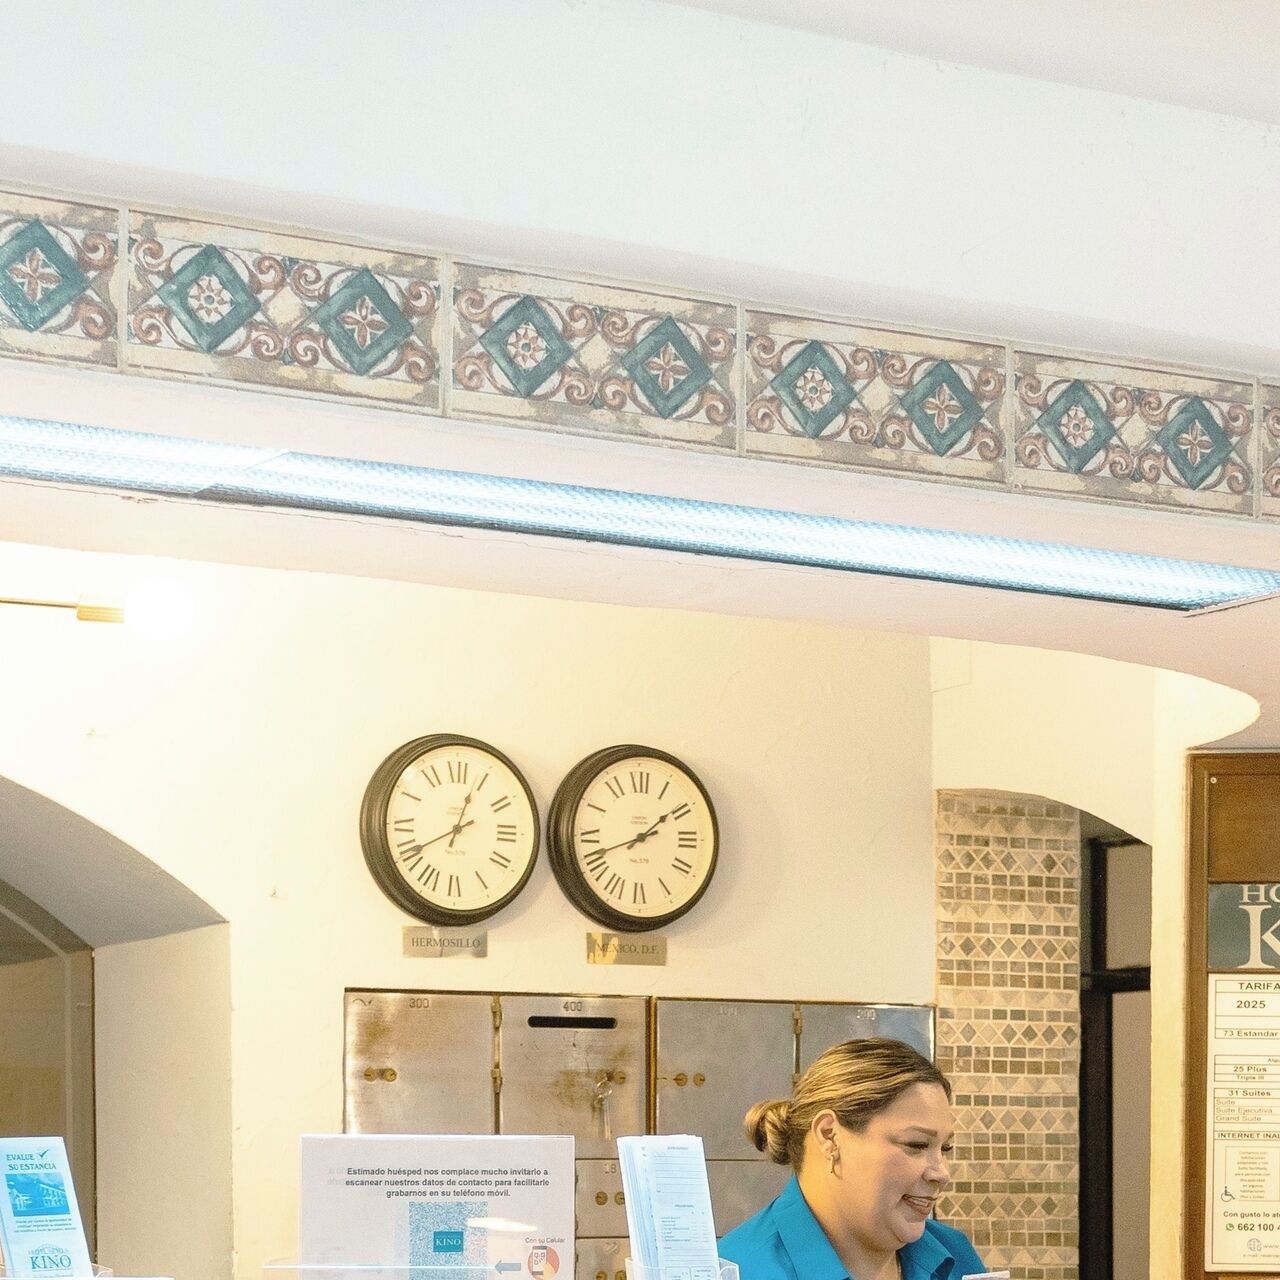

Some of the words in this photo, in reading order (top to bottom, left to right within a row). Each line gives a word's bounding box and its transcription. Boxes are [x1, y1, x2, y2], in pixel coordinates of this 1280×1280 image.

[411, 936, 482, 948] HERMOSILLO
[409, 998, 429, 1008] 300
[563, 1001, 582, 1011] 400
[1236, 1000, 1266, 1009] 2025
[1236, 1030, 1278, 1039] Estandar
[1246, 1065, 1267, 1075] Plus
[1228, 1089, 1238, 1098] 31
[1242, 1089, 1271, 1098] Suites
[1217, 1132, 1260, 1140] INTERNET
[5, 1153, 35, 1161] EVALUE
[19, 1162, 56, 1170] ESTANCIA
[346, 1167, 385, 1175] Estimado
[386, 1167, 422, 1175] huésped
[509, 1167, 541, 1175] invitarlo
[421, 1178, 444, 1186] datos
[445, 1178, 456, 1186] de
[457, 1178, 493, 1186] contacto
[494, 1179, 512, 1187] para
[513, 1178, 549, 1186] facilitarle
[385, 1190, 427, 1198] grabarnos
[452, 1188, 485, 1197] teléfono
[486, 1188, 510, 1197] móvil.
[1237, 1223, 1255, 1231] 662
[1257, 1223, 1274, 1231] 100
[30, 1254, 71, 1269] KINO
